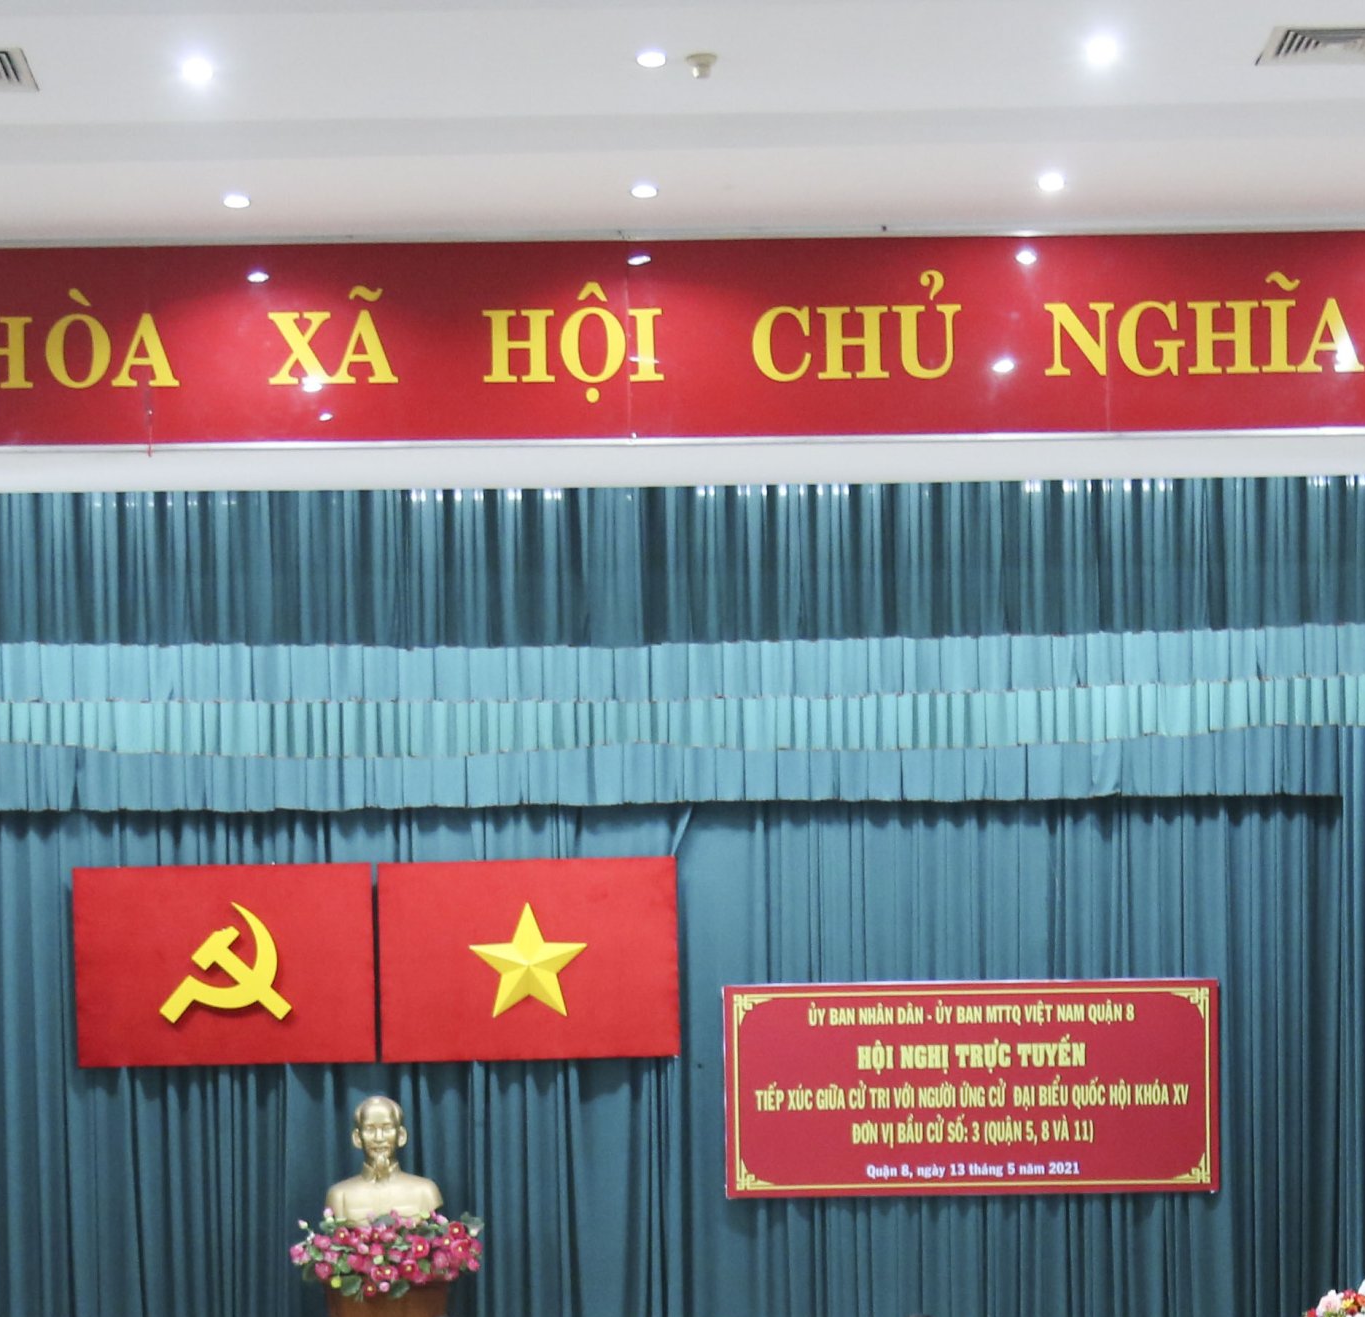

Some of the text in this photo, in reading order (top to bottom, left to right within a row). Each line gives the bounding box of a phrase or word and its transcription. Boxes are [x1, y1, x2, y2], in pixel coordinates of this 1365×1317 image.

[268, 285, 399, 386] XÃ
[482, 281, 666, 404] HỘI
[750, 269, 962, 382] CHỦ
[808, 1002, 825, 1026] ỦY
[829, 1008, 855, 1025] BAN
[859, 1003, 893, 1025] NHÂN
[897, 1002, 923, 1024] DÂN
[935, 1000, 952, 1024] ỦY
[956, 1006, 982, 1023] BAN
[986, 1005, 1021, 1025] MTTQ
[1024, 1000, 1053, 1025] VIỆT
[1057, 1004, 1084, 1021] NAM
[1088, 1000, 1122, 1024] QUẬN
[1126, 1004, 1134, 1021] 8
[858, 1034, 1085, 1074] HỘI NGHỊ TRỰC TUYẾN
[755, 1075, 1188, 1111] TIẾP XÚC GIỮA CỬ TRI VỚI NGƯỜI ỨNG CỬ ĐẠI BIỂU QUỐC HỘI KHÓA XV
[852, 1114, 1093, 1148] ĐƠN VỊ BẦU CỬ SỐ: 3 (QUẬN 5, 8 VÀ 11)
[867, 1162, 1079, 1179] Quận 8, ngày 13 tháng 5 năm 2021
